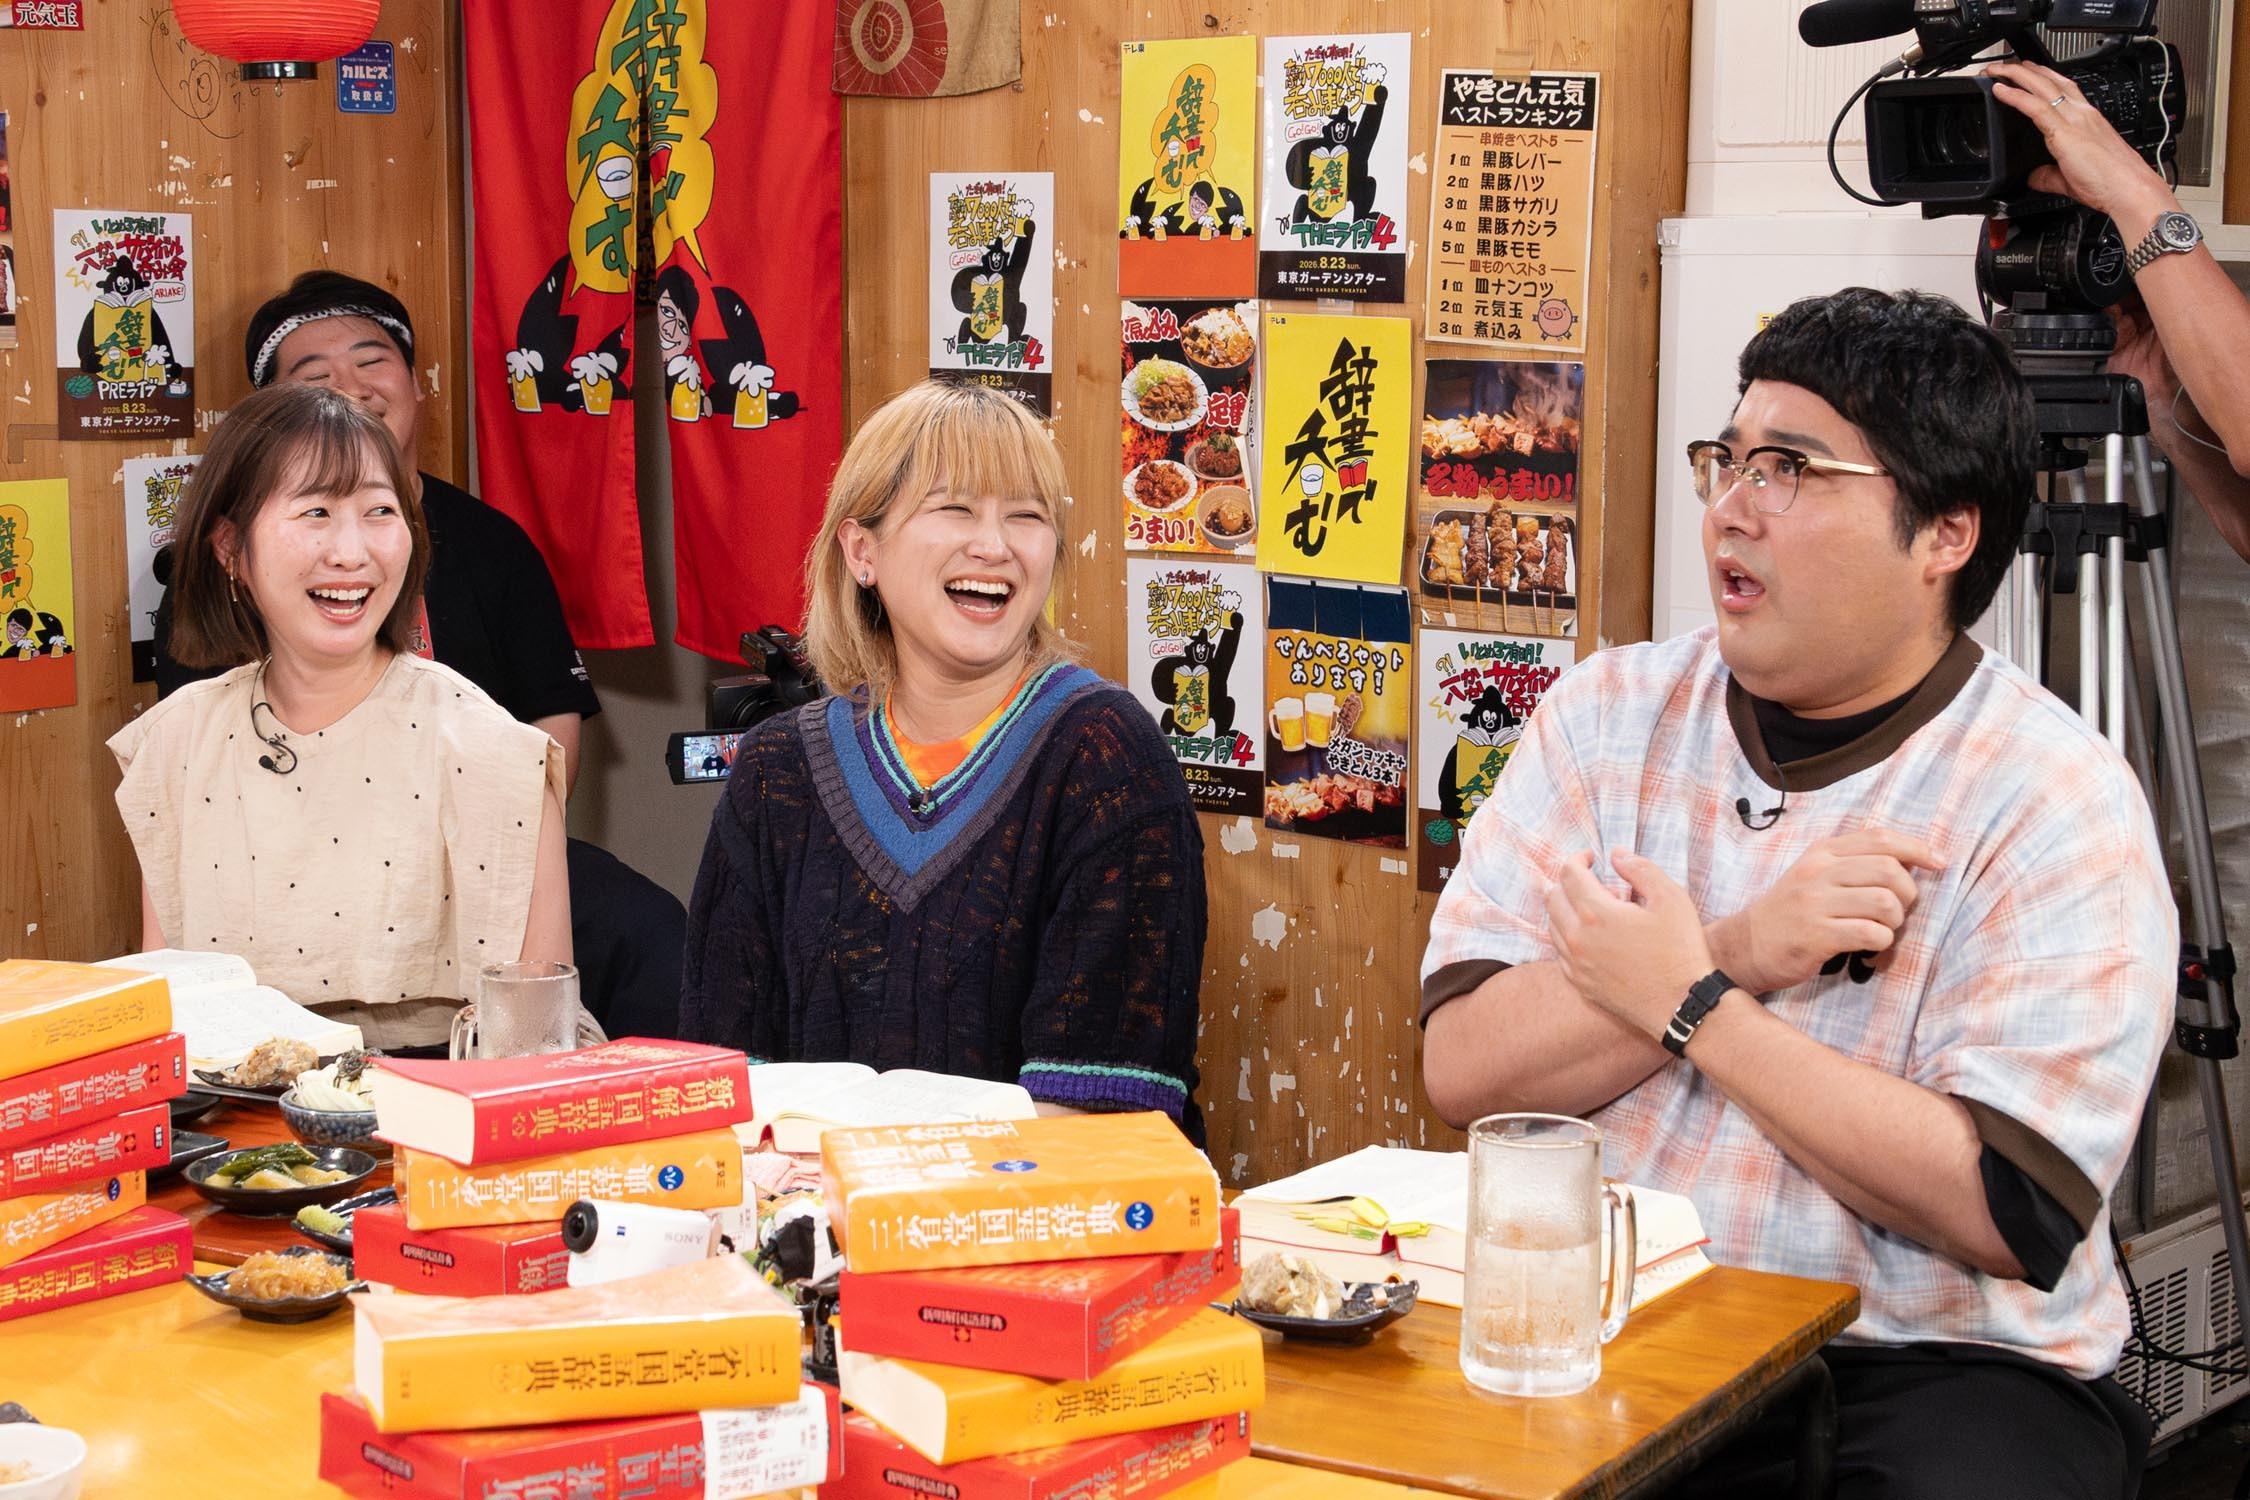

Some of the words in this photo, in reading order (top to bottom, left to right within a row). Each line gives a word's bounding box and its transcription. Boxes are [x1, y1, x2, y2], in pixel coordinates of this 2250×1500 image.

[15, 1, 79, 27] 元気玉
[1123, 43, 1145, 54] テレ東
[342, 64, 388, 79] カルピス
[1283, 81, 1363, 120] 呑みましょう
[1453, 77, 1586, 107] やきとん元気
[1450, 106, 1583, 128] ベストランキング
[1480, 132, 1558, 147] 串焼きベスト5
[1483, 151, 1562, 170] 黒豚レバー
[1480, 172, 1545, 192] 黒豚ハツ
[1479, 194, 1559, 216] 黒豚サガリ
[948, 217, 1016, 249] 呑みましょう
[1477, 216, 1558, 237] 黒豚カシラ
[1476, 239, 1541, 259] 黒豚モモ
[1996, 253, 2034, 264] sachtler
[1299, 260, 1319, 269] 2026.
[1319, 257, 1346, 270] 8.23
[1469, 259, 1546, 276] 皿ものベスト3
[1277, 271, 1387, 285] 東京ガーデンシアター
[1475, 278, 1554, 298] 皿ナンコツ
[154, 286, 184, 298] ARIAKE!
[1474, 299, 1524, 320] 元気玉
[1474, 320, 1522, 341] 煮込み
[97, 379, 158, 400] PREライブ
[122, 402, 146, 414] 8.23
[1207, 392, 1248, 428] 定番
[80, 415, 180, 428] 東京ガーデンシアター
[1320, 337, 1378, 524] 辞書で
[1127, 514, 1196, 545] うまい!
[1146, 607, 1222, 639] 呑みましょう
[1275, 636, 1404, 672] せんべろセット
[1290, 660, 1384, 696] あります!
[1483, 660, 1561, 695] サバイバル
[1505, 688, 1542, 718] 呑み
[1326, 753, 1401, 787] やきとん3本!
[1187, 783, 1247, 798] デンシアター
[0, 1062, 148, 1131] 明解国語辞典
[528, 1075, 736, 1141] 新明解国語辞典
[427, 1159, 655, 1209] 三省堂国語辞典
[869, 1200, 1121, 1251] 三省堂国語辞典
[664, 1232, 704, 1245] SONY
[525, 1344, 777, 1393] 三省堂国語辞典
[1055, 1360, 1247, 1422] 三省堂国語辞典
